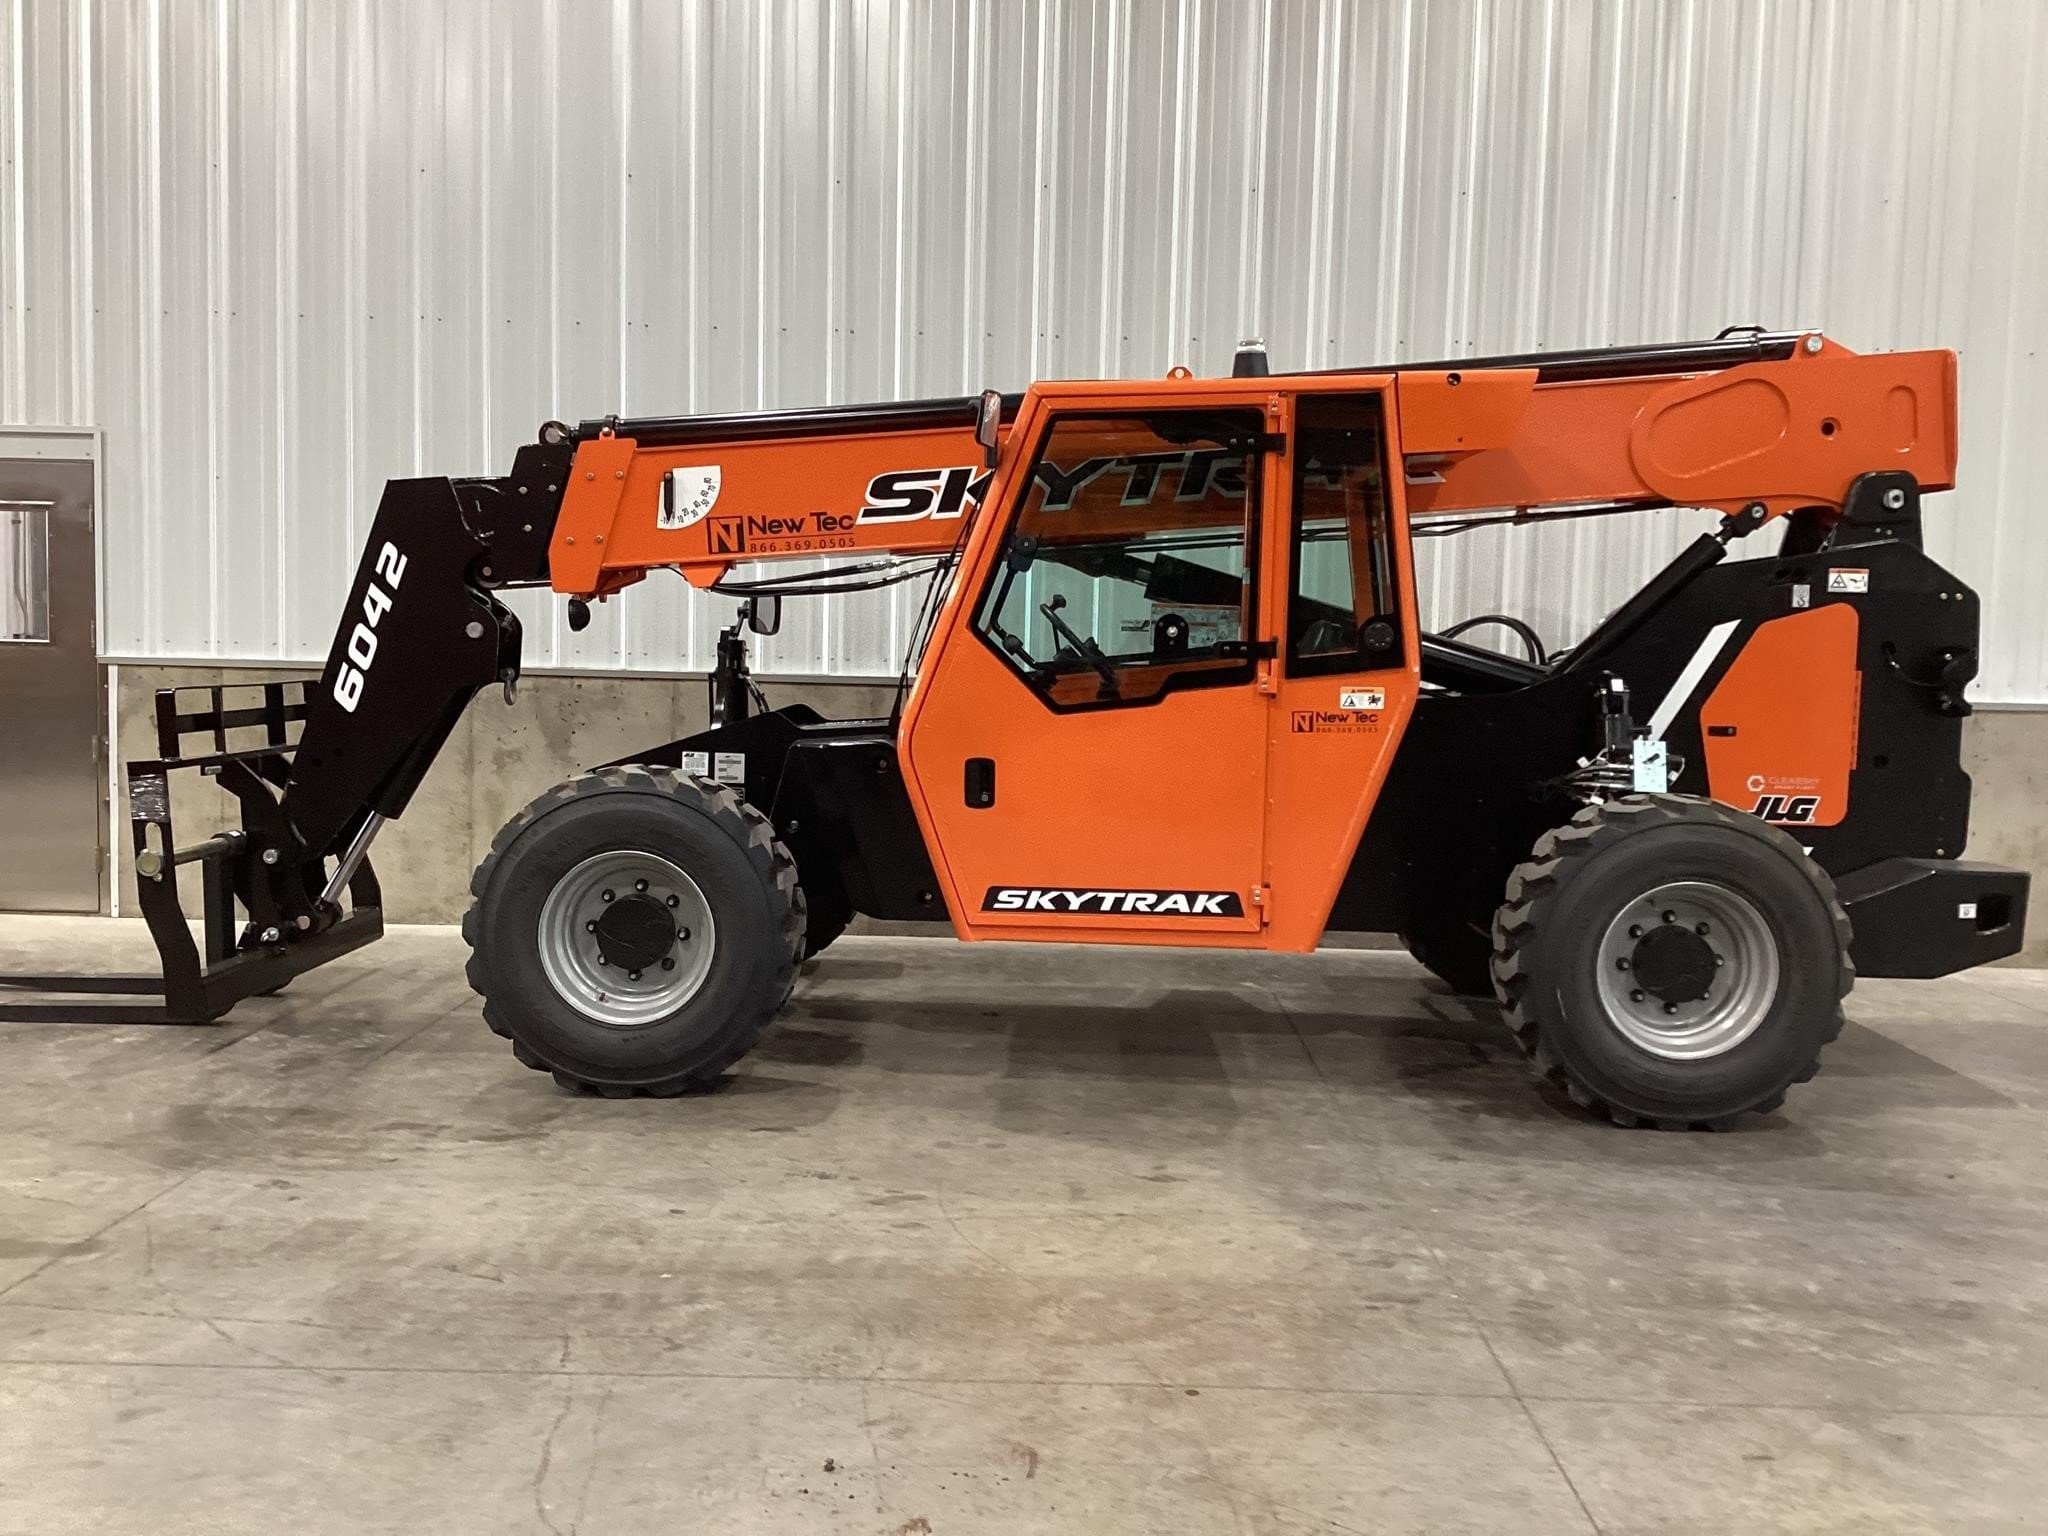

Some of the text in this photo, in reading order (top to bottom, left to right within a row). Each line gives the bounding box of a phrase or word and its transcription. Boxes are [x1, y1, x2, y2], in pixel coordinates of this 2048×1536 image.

[748, 512, 855, 535] New Tec
[750, 538, 856, 553] 866.369.0505
[333, 541, 408, 713] 6042
[1315, 711, 1379, 723] New Tec
[1746, 794, 1821, 824] JLG
[992, 889, 1231, 914] SKYTRAK
